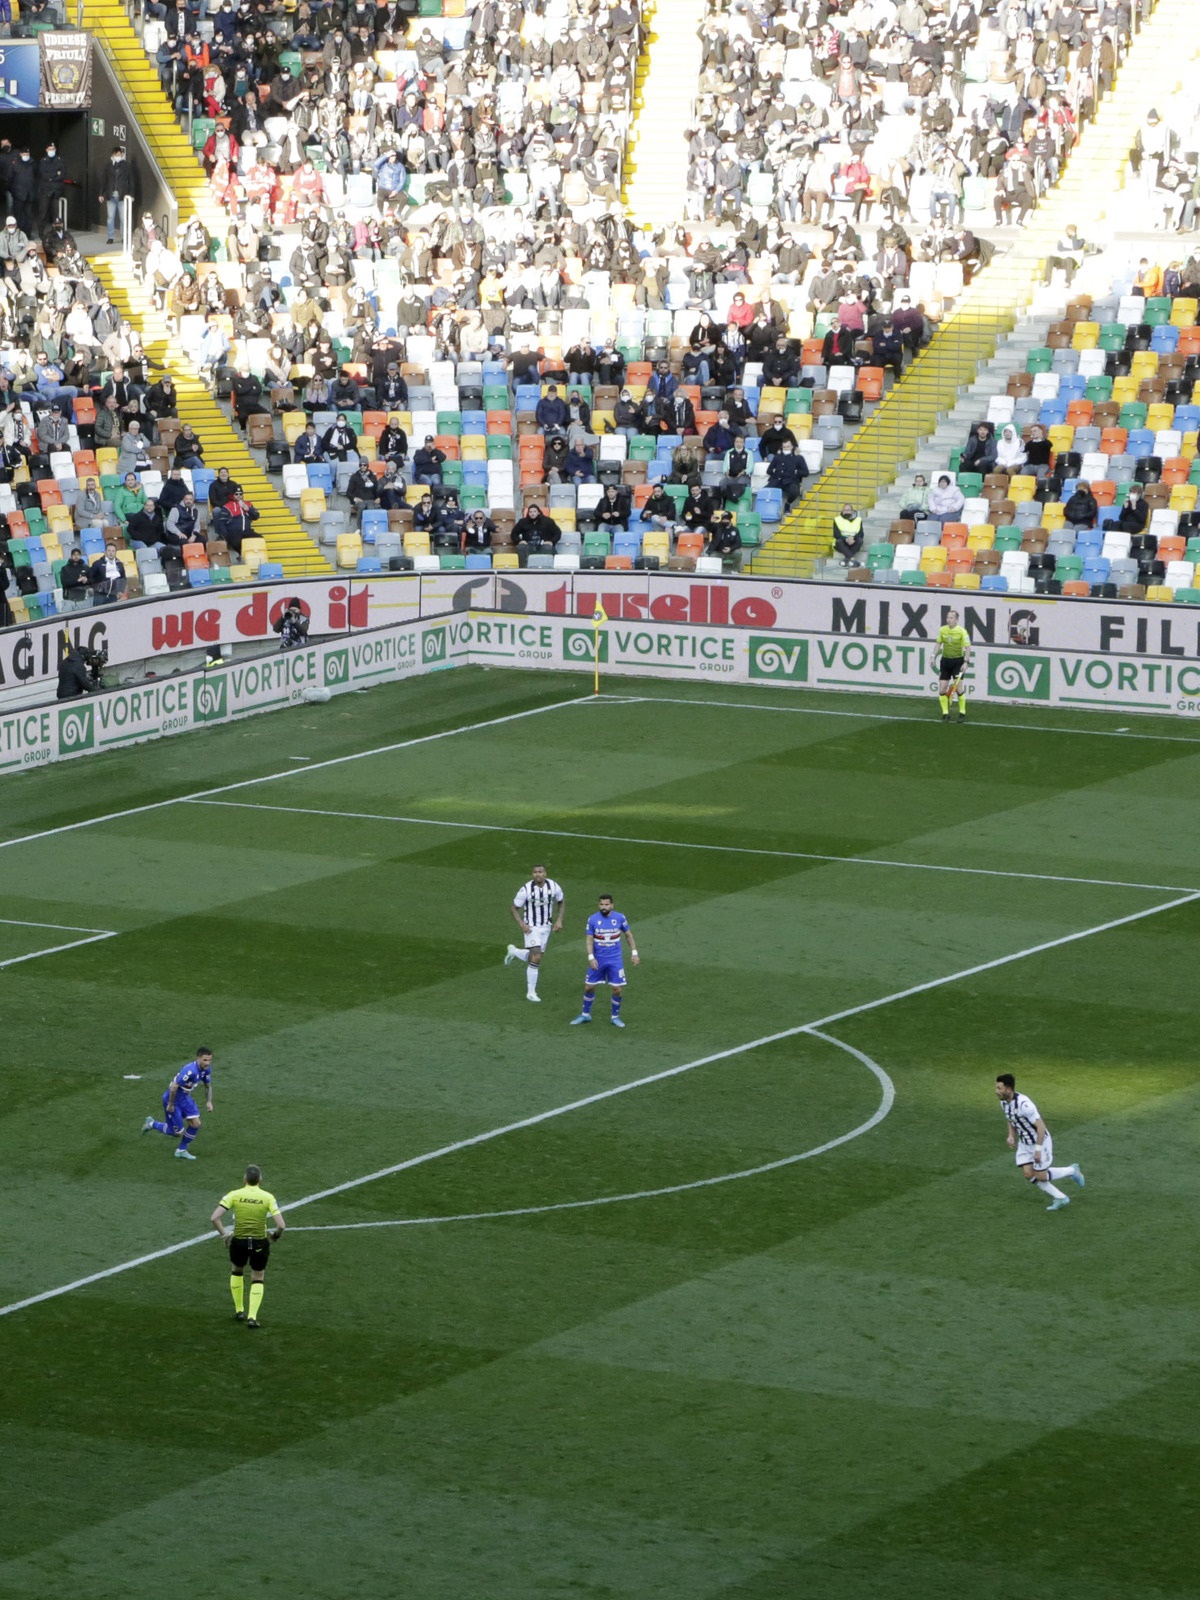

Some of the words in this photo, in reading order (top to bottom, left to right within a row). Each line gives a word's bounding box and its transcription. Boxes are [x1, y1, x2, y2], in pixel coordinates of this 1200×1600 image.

[43, 33, 87, 46] UDINESE
[113, 125, 120, 136] F2
[152, 608, 222, 651] we
[328, 584, 374, 629] it
[450, 621, 552, 648] VORTICE
[352, 633, 416, 668] VORTICE
[616, 631, 735, 660] VORTICE
[518, 650, 553, 660] GROUP
[817, 640, 975, 679] VORTIE
[397, 658, 416, 671] GROUP
[699, 662, 734, 673] GROUP
[232, 651, 317, 696] VORTICE
[99, 681, 188, 728] VORTICE
[162, 716, 188, 731] GROUP
[24, 748, 51, 763] GROUP
[239, 1197, 264, 1205] LEGEA
